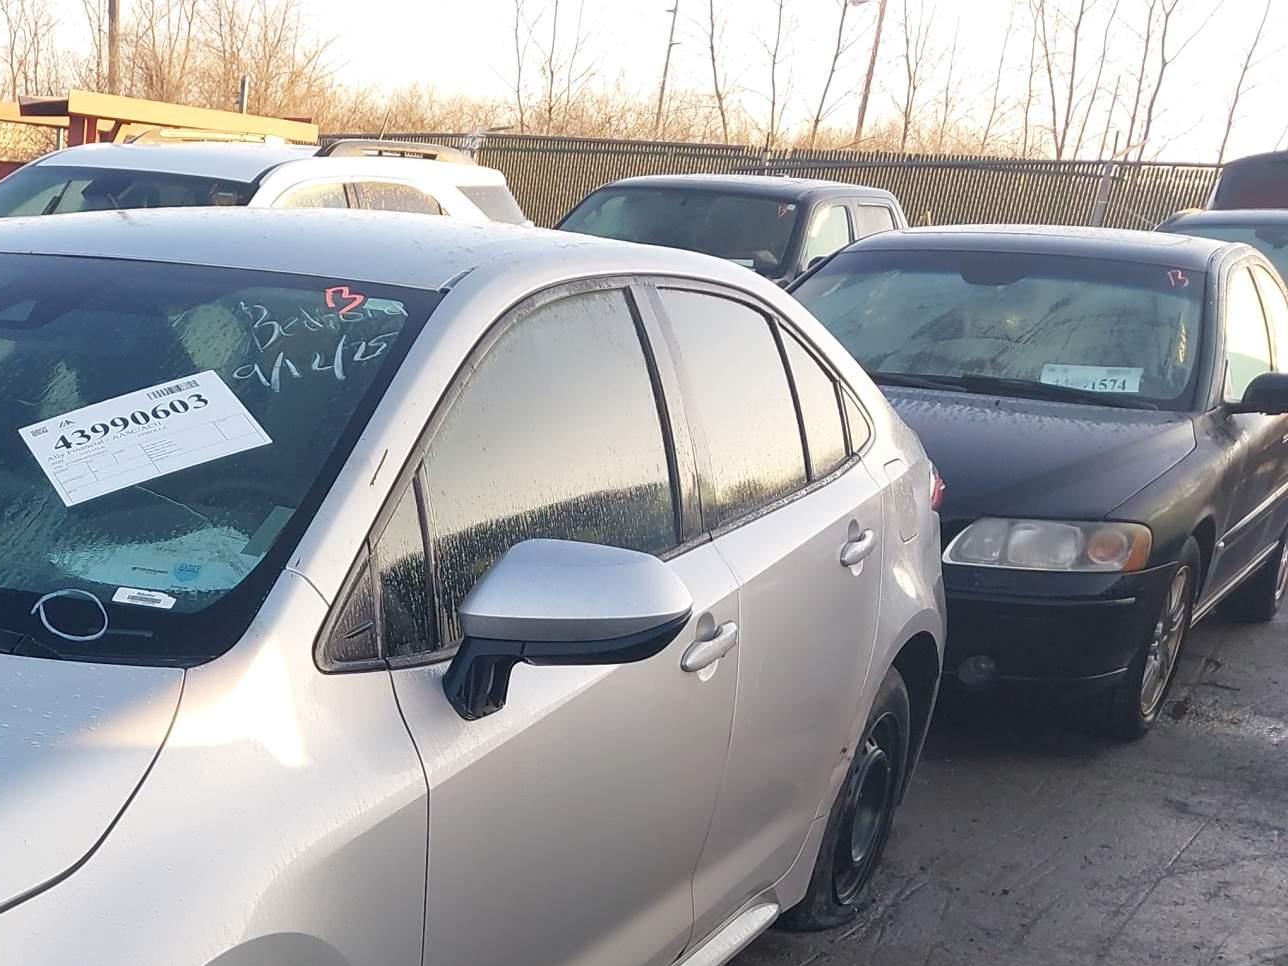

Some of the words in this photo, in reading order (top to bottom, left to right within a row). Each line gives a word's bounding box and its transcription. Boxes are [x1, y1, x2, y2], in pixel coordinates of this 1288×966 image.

[54, 393, 209, 450] 43990603
[48, 453, 65, 462] Ally
[66, 439, 105, 455] Financial
